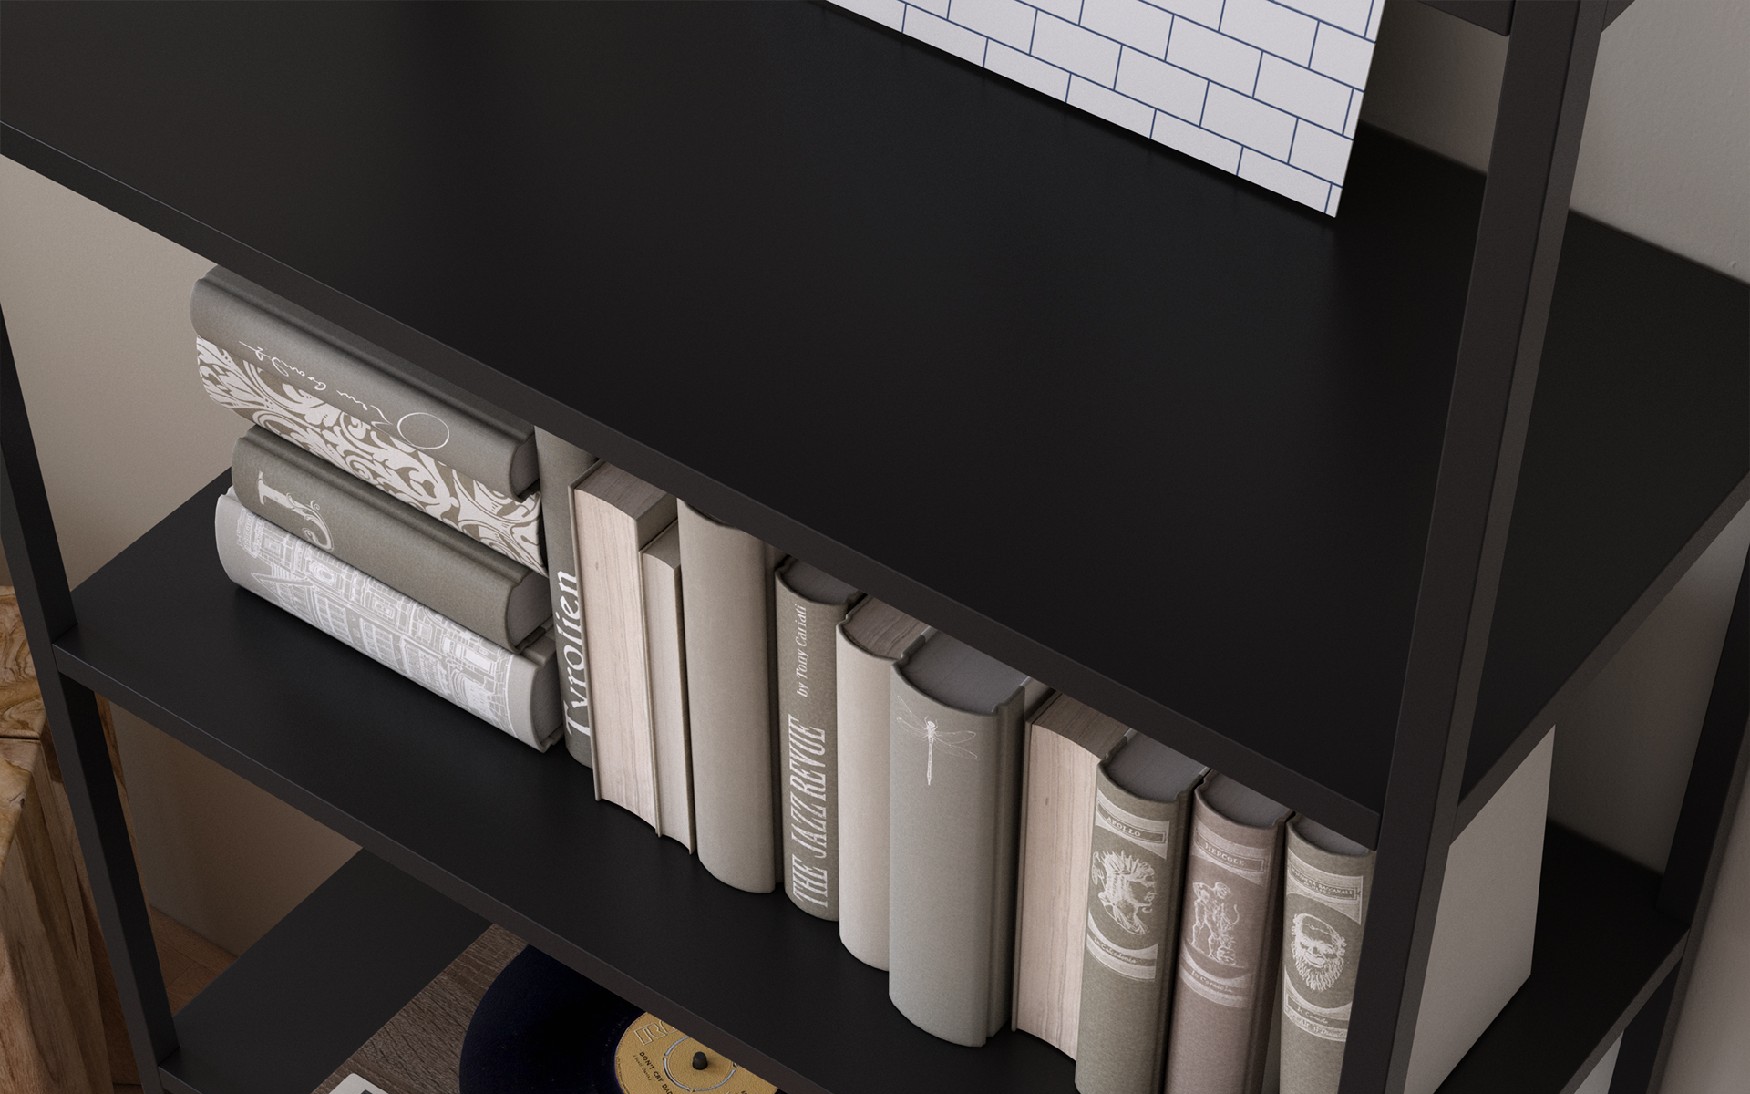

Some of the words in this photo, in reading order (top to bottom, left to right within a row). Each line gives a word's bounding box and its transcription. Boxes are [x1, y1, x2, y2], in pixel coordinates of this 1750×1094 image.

[555, 571, 592, 736] Tyrolien
[796, 648, 808, 679] Tony
[797, 682, 808, 697] by
[788, 713, 826, 801] REVUE
[790, 792, 827, 859] JAZZ
[1105, 815, 1141, 838] APOLLO
[792, 854, 828, 908] THE
